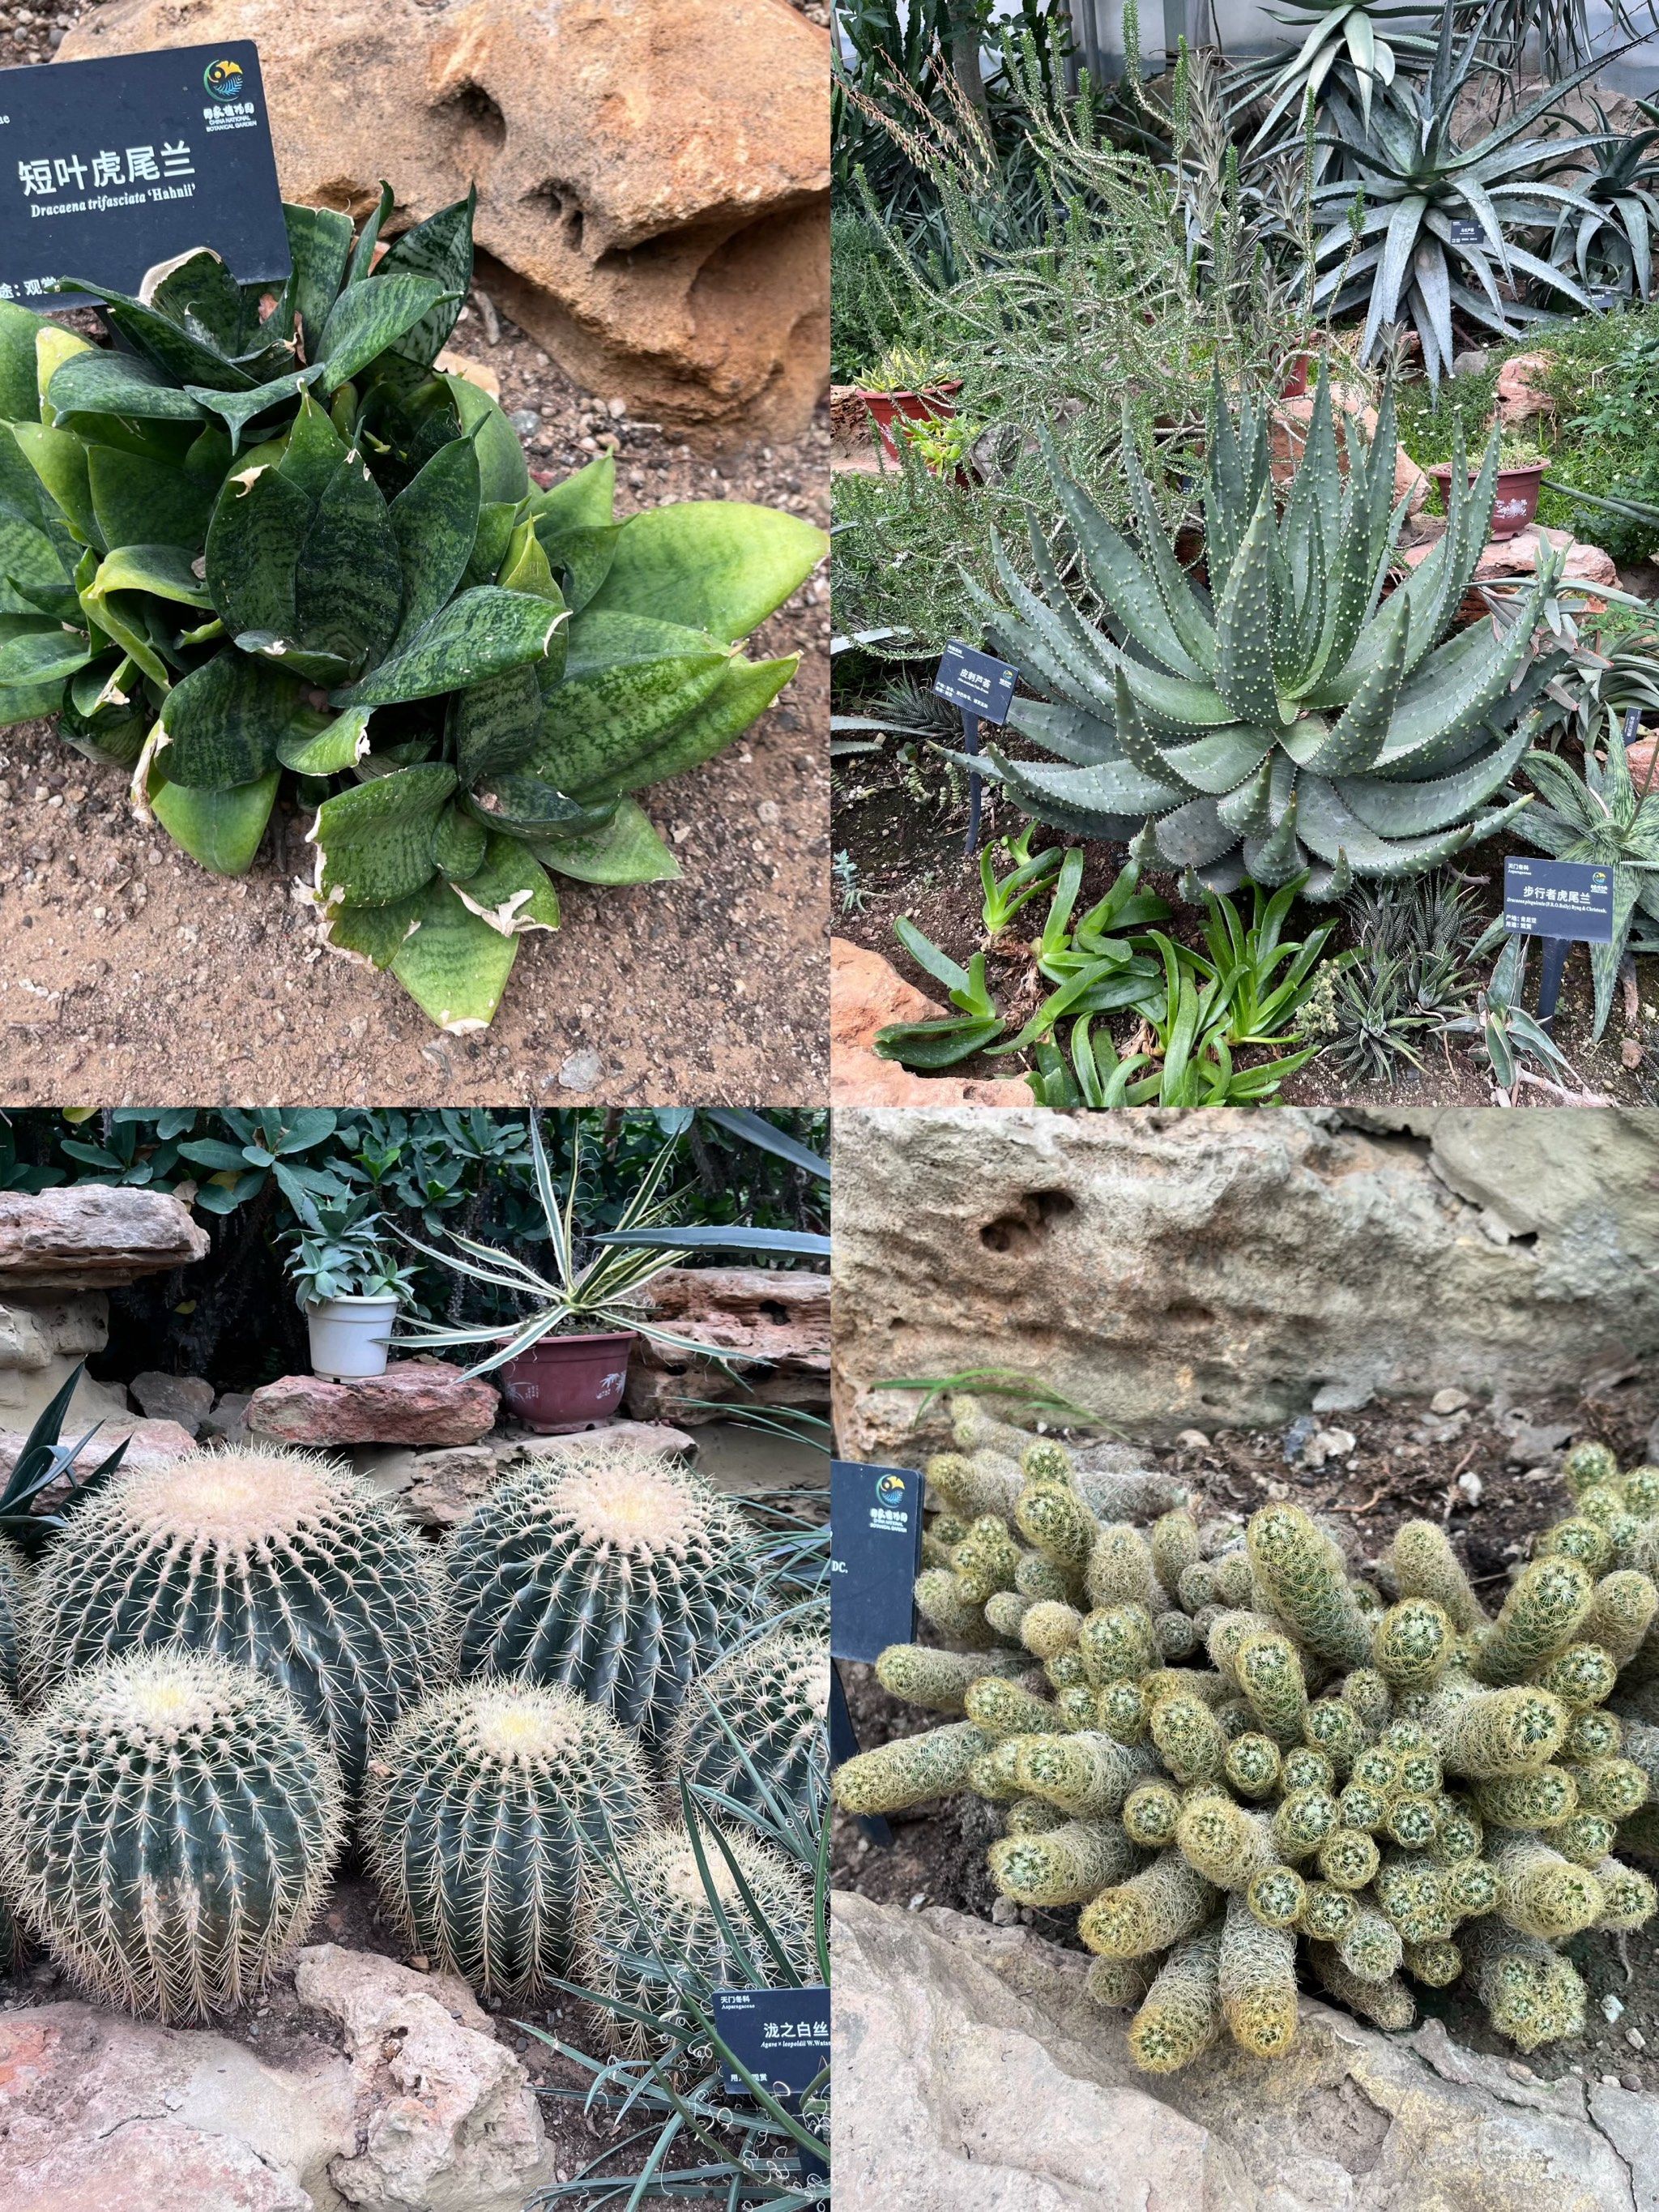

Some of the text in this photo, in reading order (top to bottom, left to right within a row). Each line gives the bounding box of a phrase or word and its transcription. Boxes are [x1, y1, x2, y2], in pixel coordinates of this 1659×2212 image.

[206, 120, 257, 132] BOTANICAL GARDEN
[225, 115, 251, 124] NATIONAL
[18, 140, 195, 197] 短叶虎尾兰
[31, 202, 87, 218] Dracaena
[87, 192, 146, 212] trifasciata
[1523, 886, 1591, 904] 步行者虎尾兰
[831, 1560, 848, 1574] DC.
[720, 1995, 750, 2004] 天门冬科
[763, 2021, 829, 2038] 泷之白丝
[761, 2041, 778, 2049] Agave
